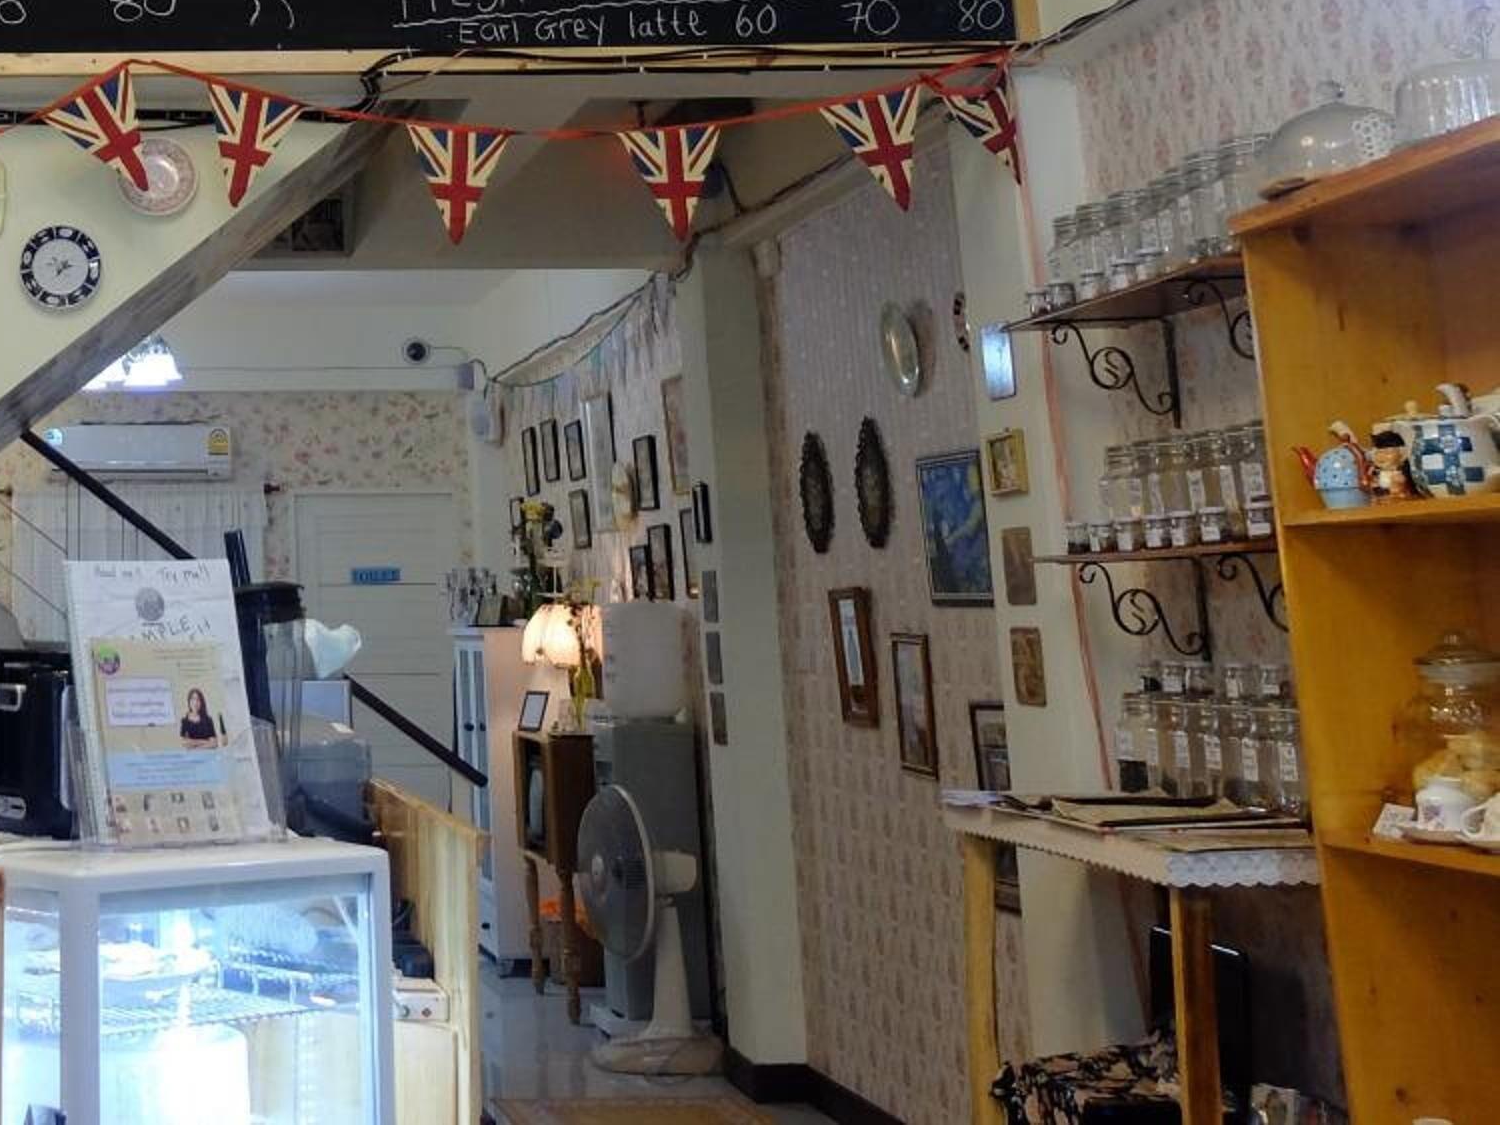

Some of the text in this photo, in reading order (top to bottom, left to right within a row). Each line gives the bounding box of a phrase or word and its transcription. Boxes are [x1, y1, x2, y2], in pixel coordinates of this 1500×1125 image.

[458, 20, 519, 44] Earl
[534, 14, 604, 45] Grey
[629, 7, 707, 39] latte
[735, 3, 777, 37] 60
